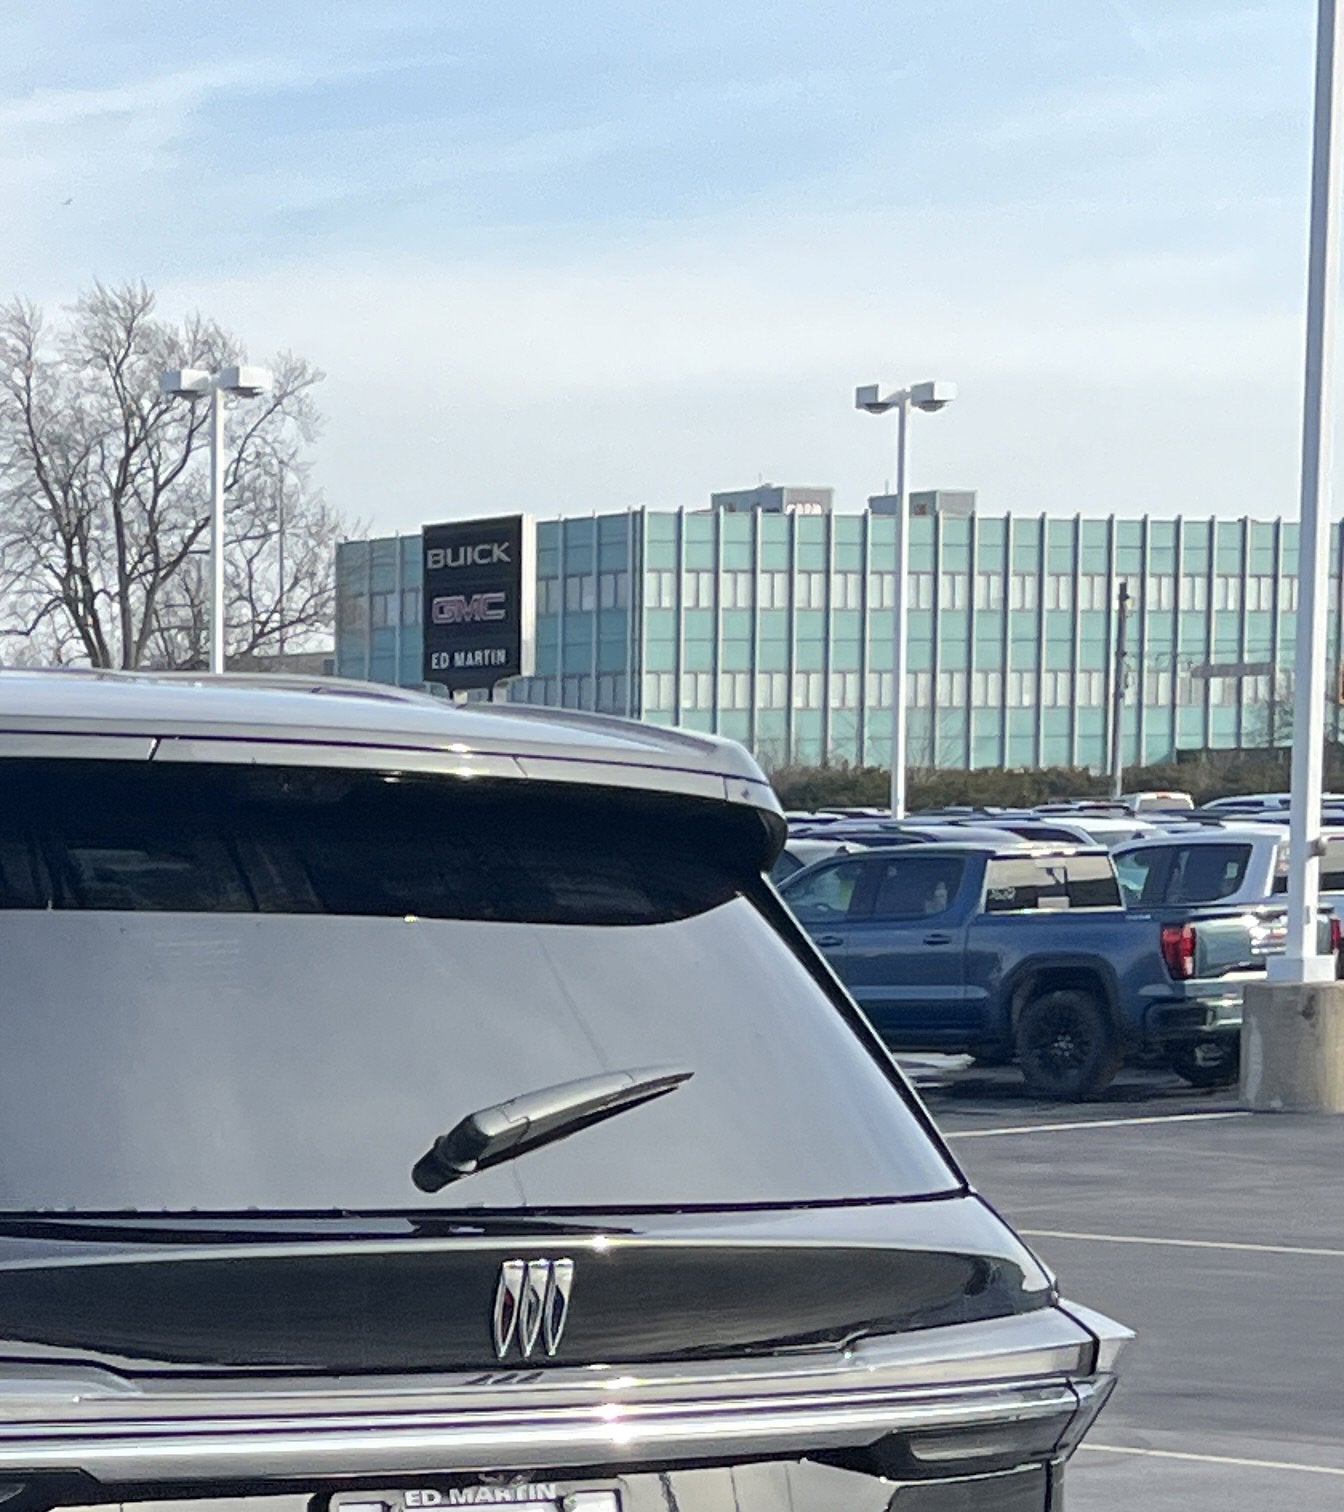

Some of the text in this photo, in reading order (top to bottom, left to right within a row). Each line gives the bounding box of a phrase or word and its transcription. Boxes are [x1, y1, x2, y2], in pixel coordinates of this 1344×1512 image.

[426, 541, 511, 569] BUICK
[432, 592, 506, 624] GMC
[431, 649, 506, 670] ED MARTIN
[404, 1483, 558, 1506] ED MARTIN
